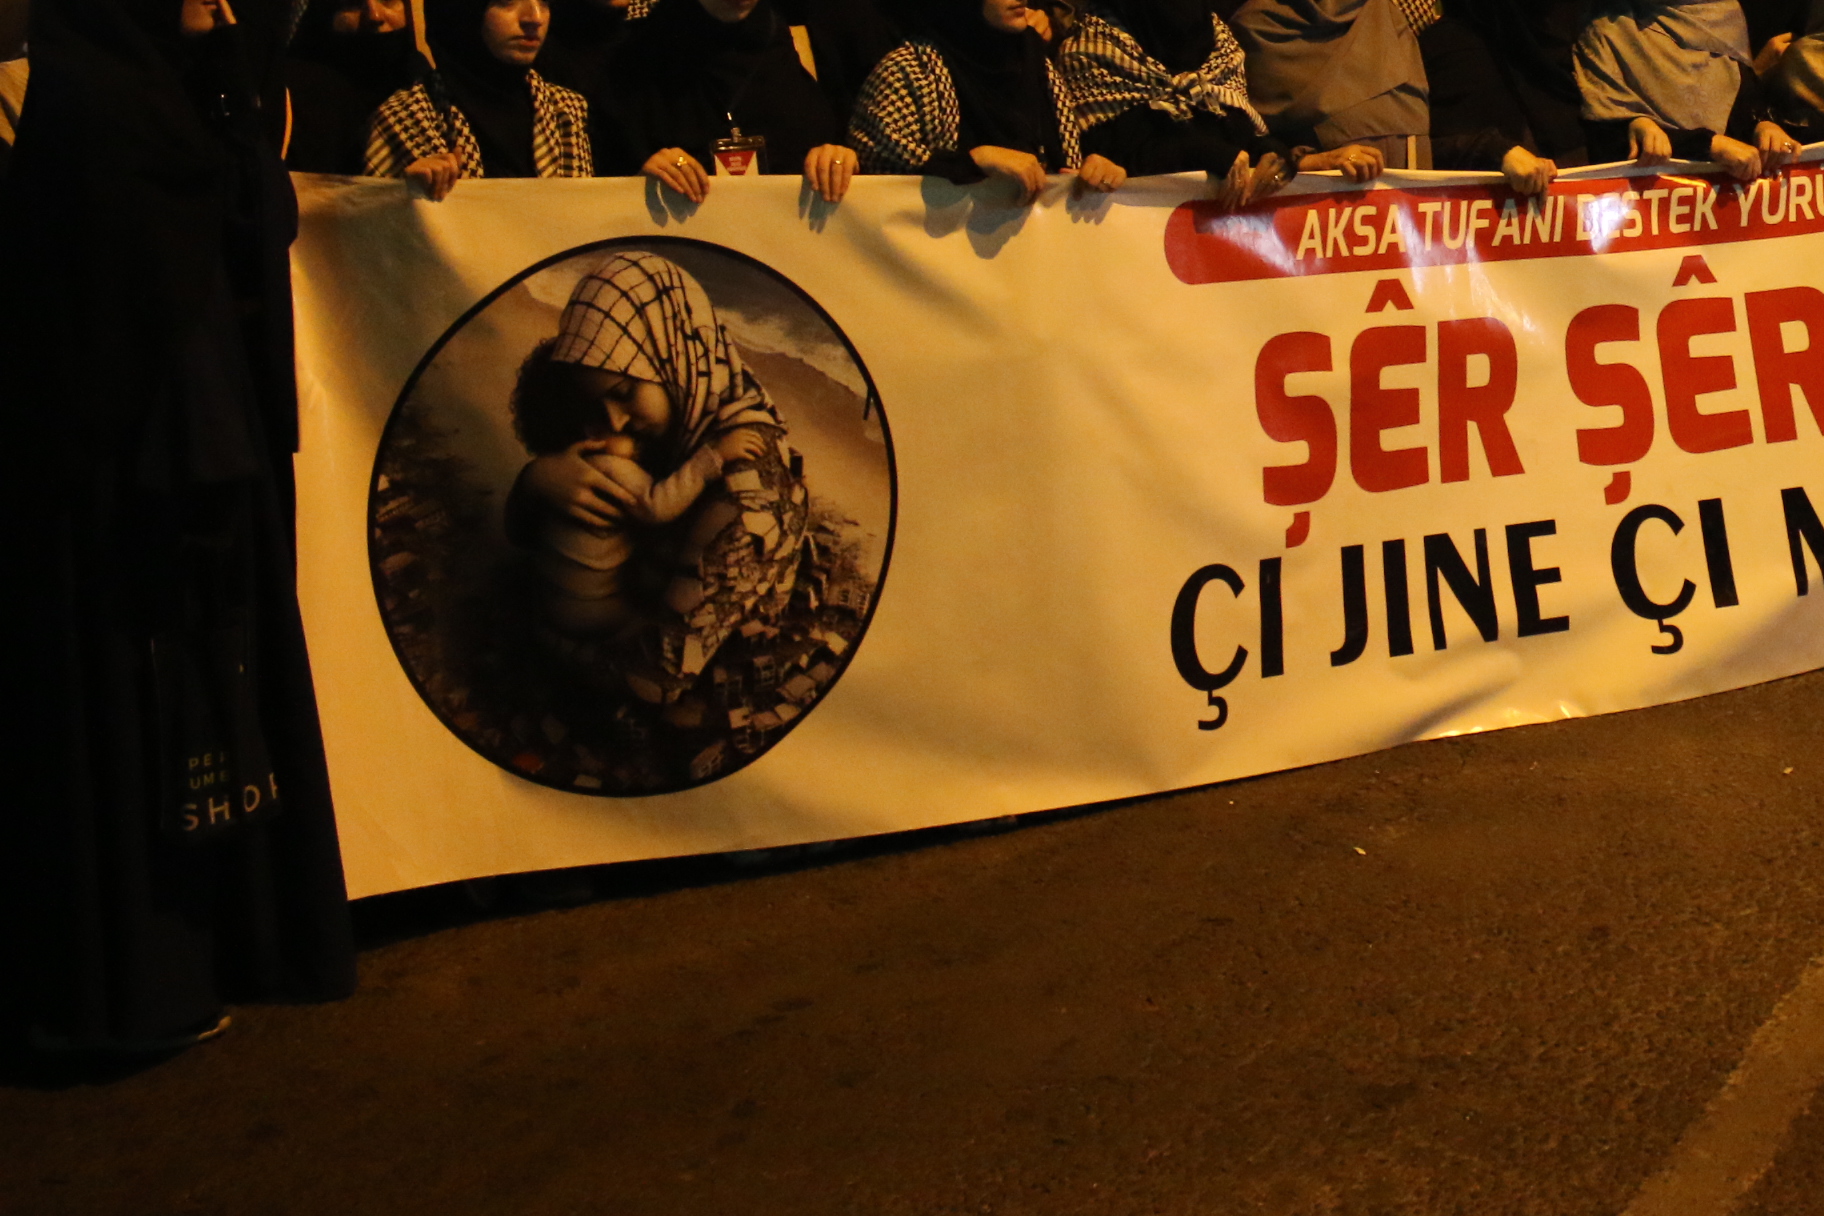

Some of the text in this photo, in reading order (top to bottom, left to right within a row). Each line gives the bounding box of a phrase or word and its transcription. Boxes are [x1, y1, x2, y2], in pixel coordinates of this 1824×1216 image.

[1296, 203, 1406, 261] AKSA
[1417, 194, 1566, 252] TUFANI
[1575, 184, 1719, 243] DESTEK
[1254, 278, 1527, 550] ŞÊR
[1169, 554, 1287, 732] ÇI
[1329, 518, 1572, 668] JINE
[1609, 496, 1741, 656] ÇI
